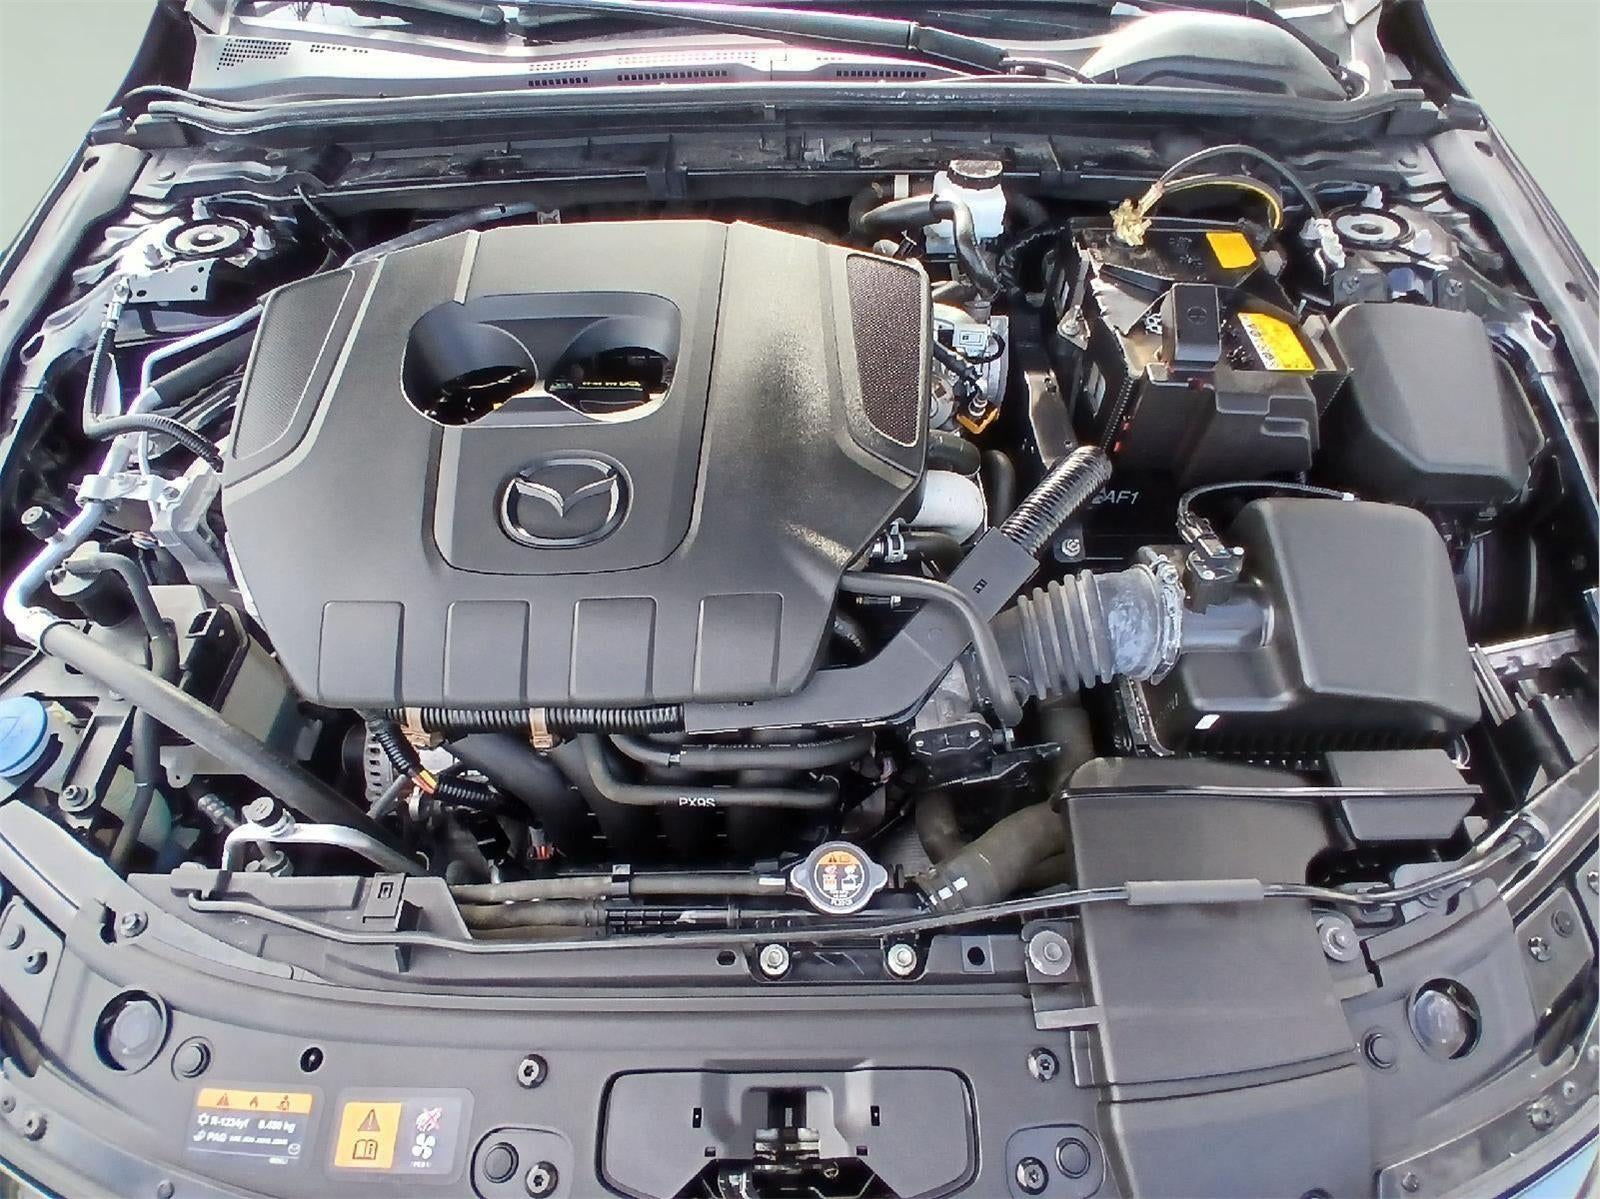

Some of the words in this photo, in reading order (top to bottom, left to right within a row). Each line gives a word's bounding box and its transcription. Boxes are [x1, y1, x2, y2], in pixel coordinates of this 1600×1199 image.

[210, 1115, 250, 1130] R-1234yf
[283, 1120, 297, 1133] kg
[206, 1131, 228, 1142] PAG
